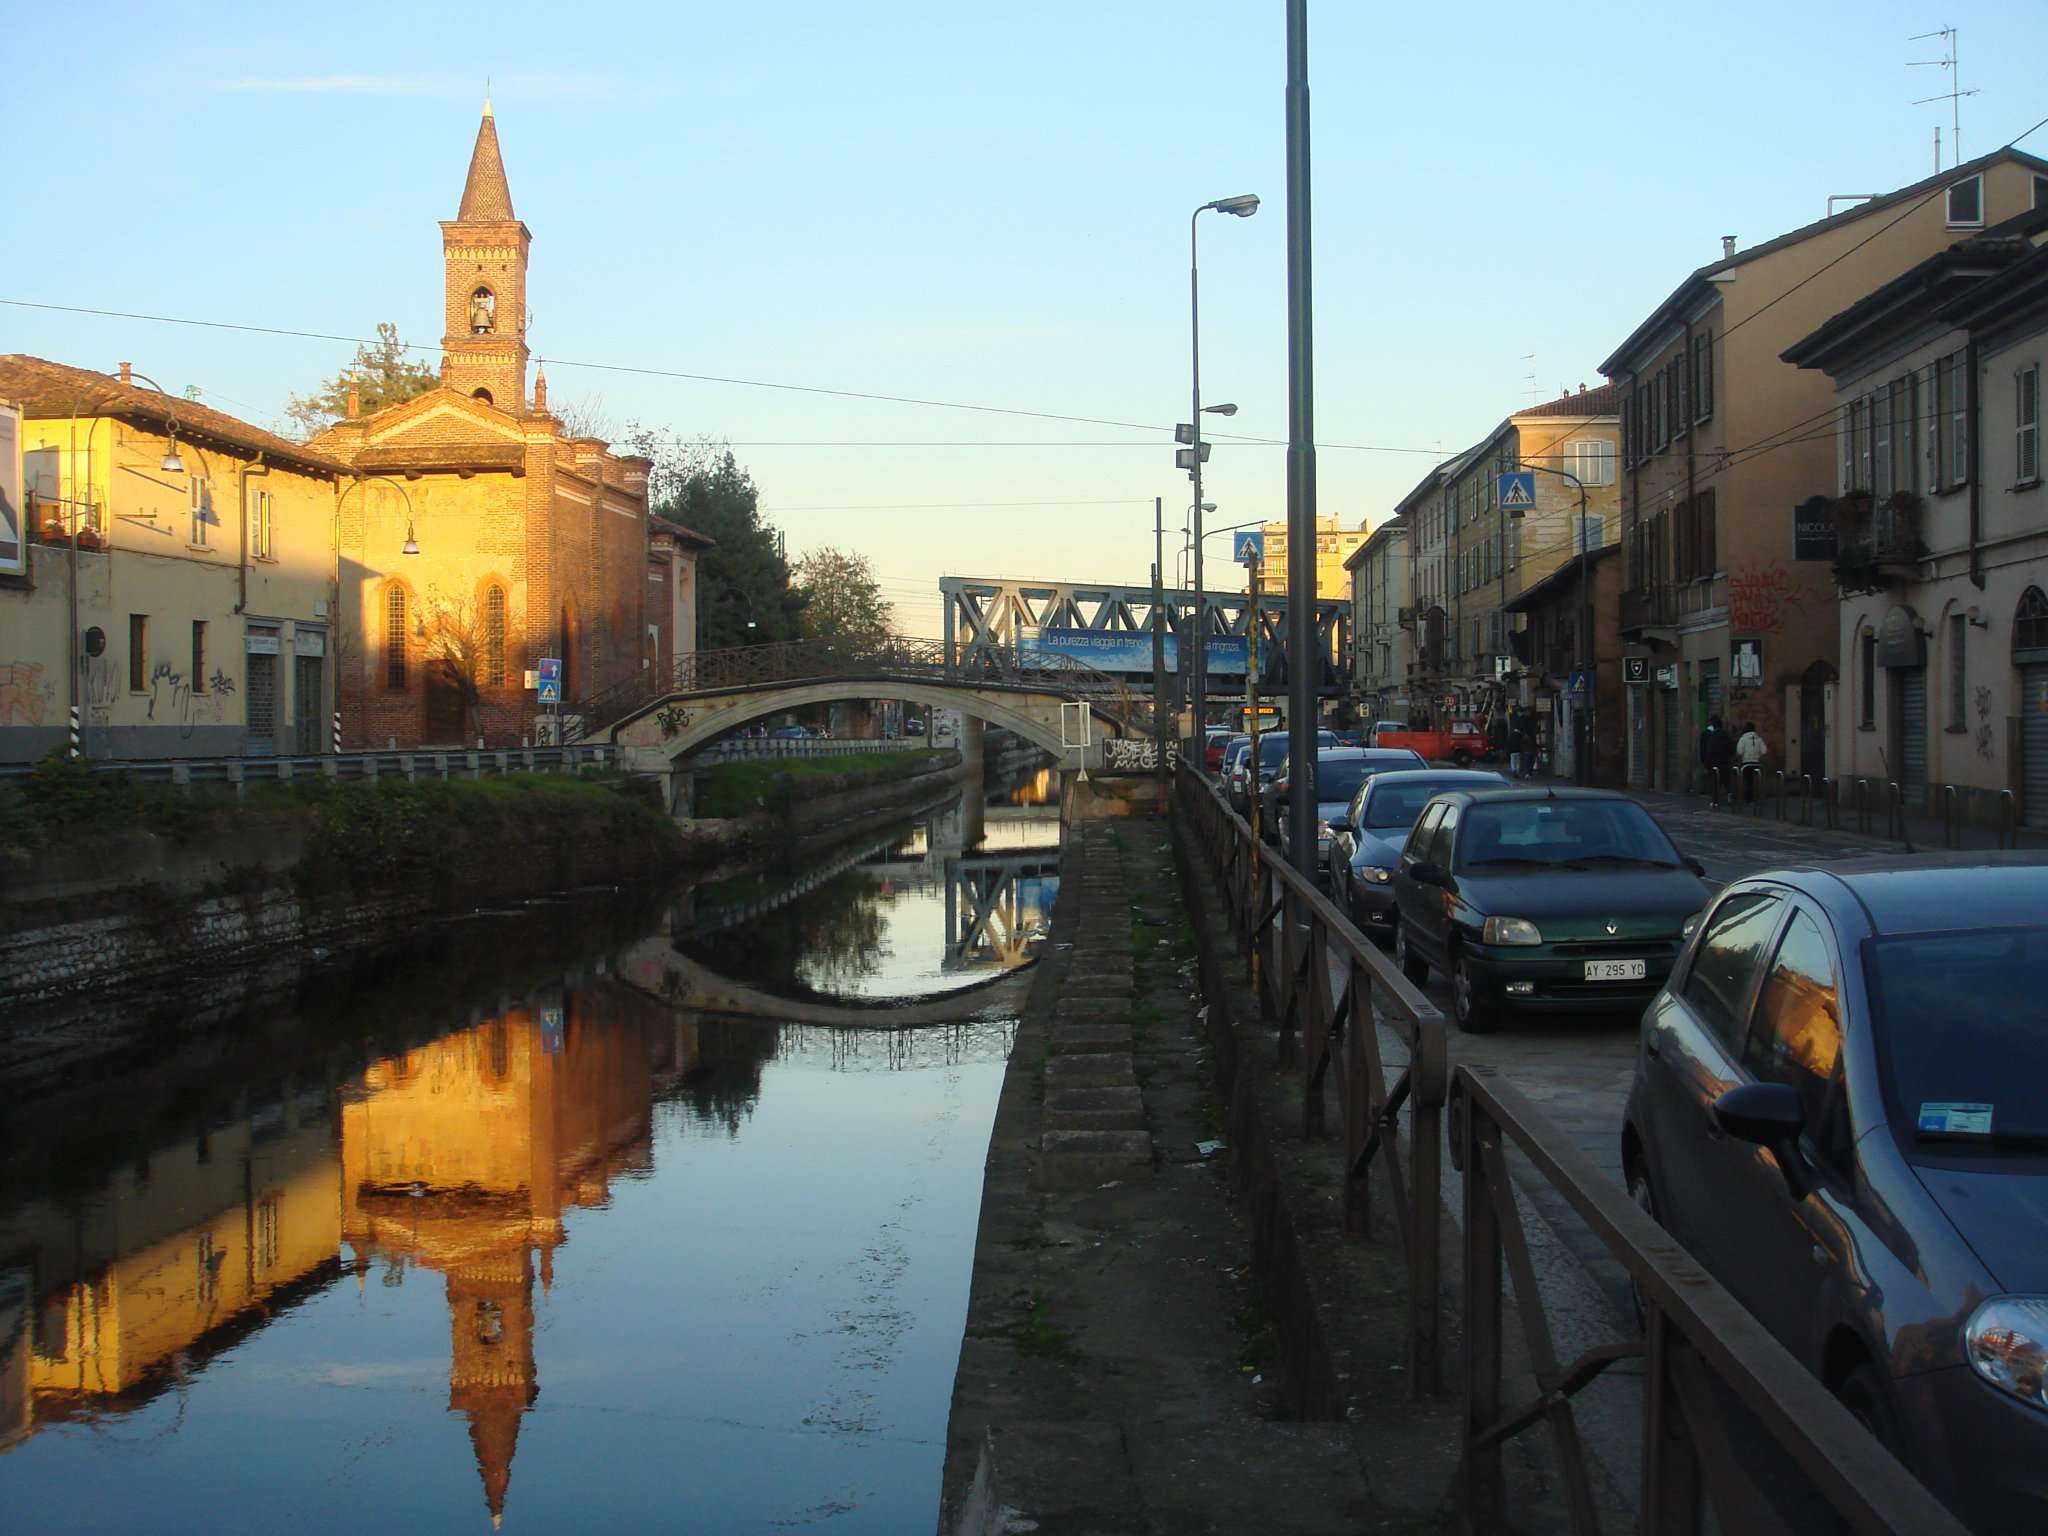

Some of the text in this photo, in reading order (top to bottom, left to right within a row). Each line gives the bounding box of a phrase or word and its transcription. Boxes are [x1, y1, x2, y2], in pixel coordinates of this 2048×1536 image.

[1047, 632, 1058, 646] La
[1060, 636, 1089, 648] purezza
[1091, 635, 1115, 650] viaggia
[1116, 637, 1124, 648] in
[1498, 656, 1509, 671] T
[1586, 965, 1599, 976] AY
[1605, 964, 1625, 976] 295
